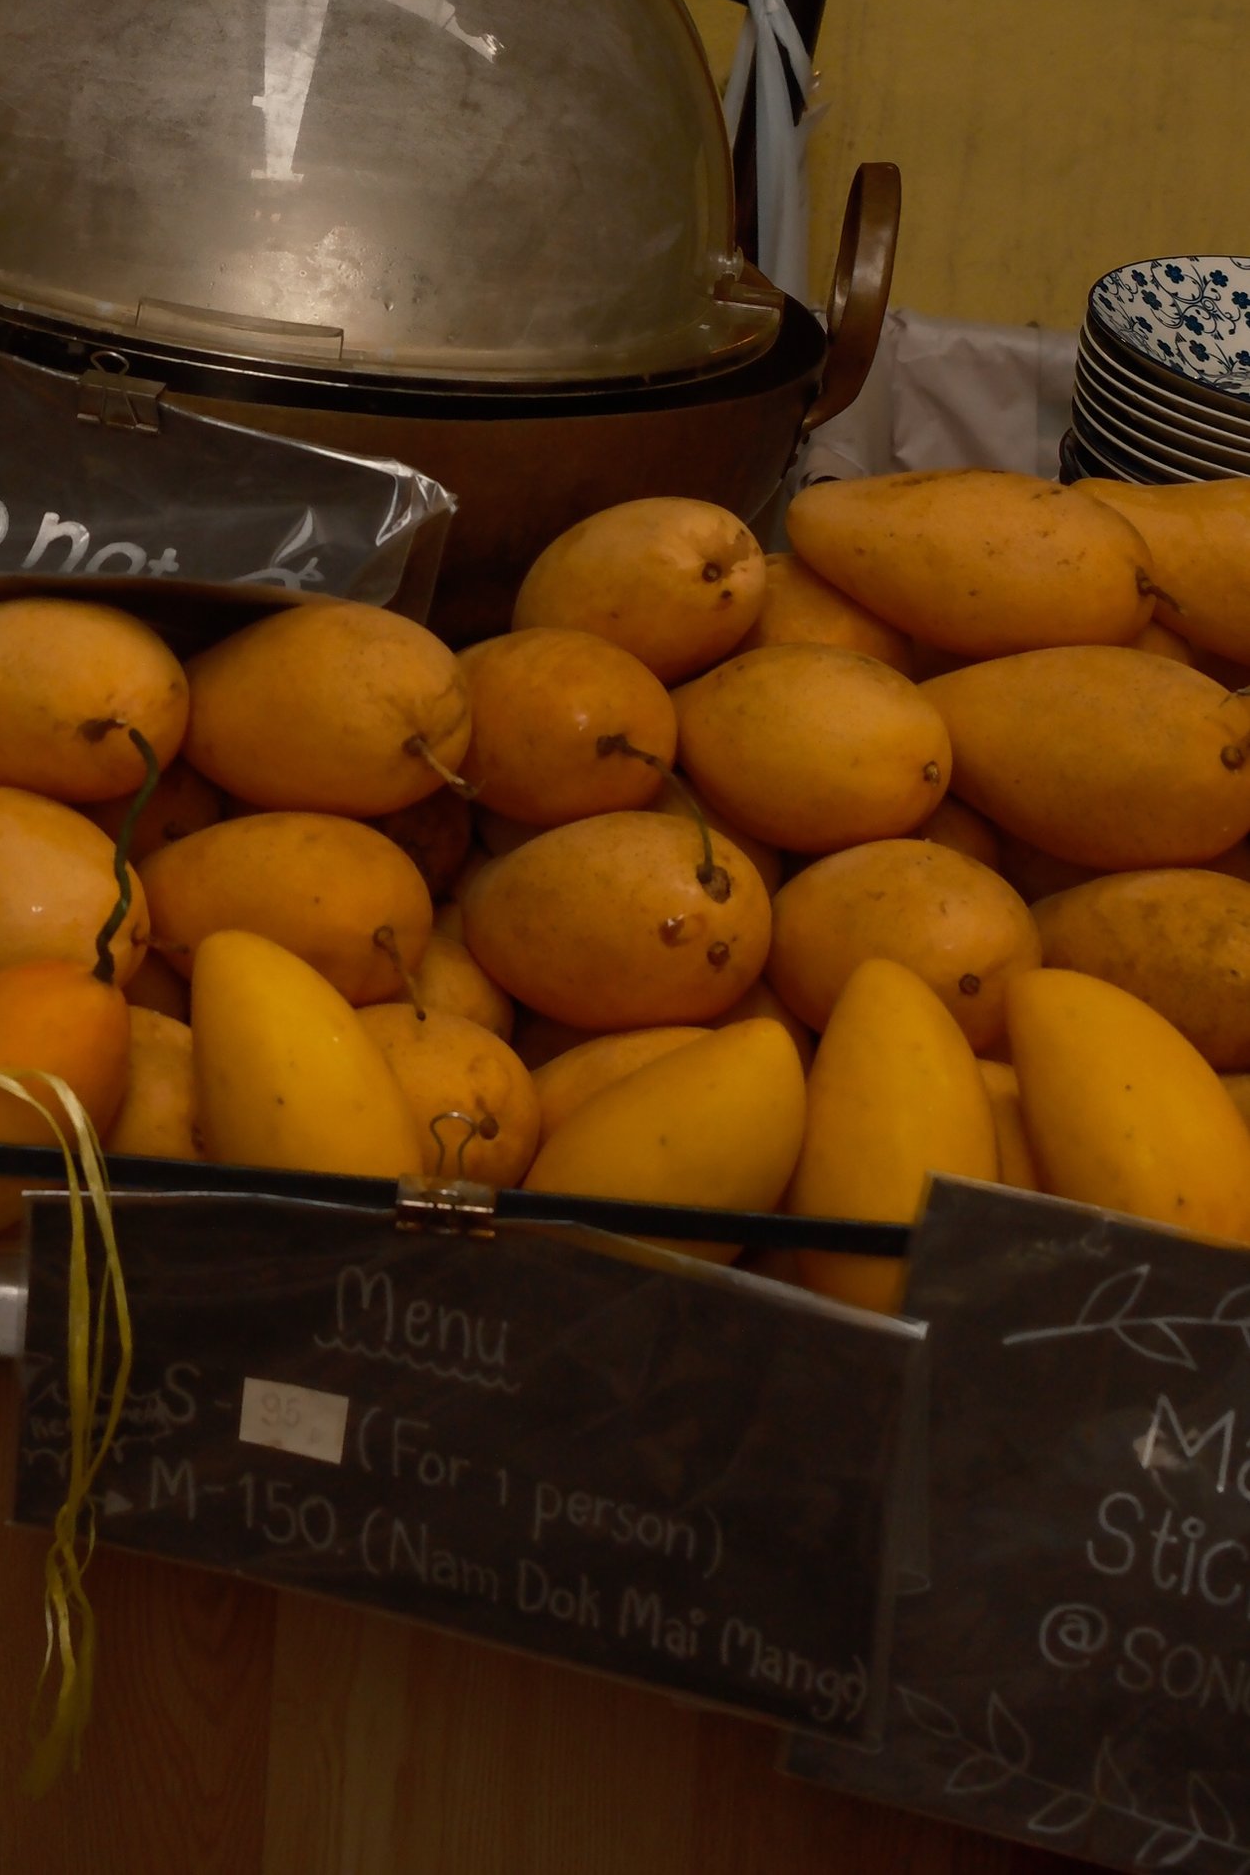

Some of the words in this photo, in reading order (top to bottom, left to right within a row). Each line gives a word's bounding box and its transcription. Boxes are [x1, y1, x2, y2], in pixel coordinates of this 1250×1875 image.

[336, 1264, 510, 1363] Menu
[162, 1361, 203, 1424] S
[356, 1405, 470, 1489] (For
[495, 1466, 510, 1506] 1
[532, 1482, 724, 1579] person)
[361, 1506, 499, 1604] (Nam
[517, 1558, 601, 1630] Dok
[618, 1585, 708, 1659] Mai
[1086, 1491, 1250, 1619] Stic
